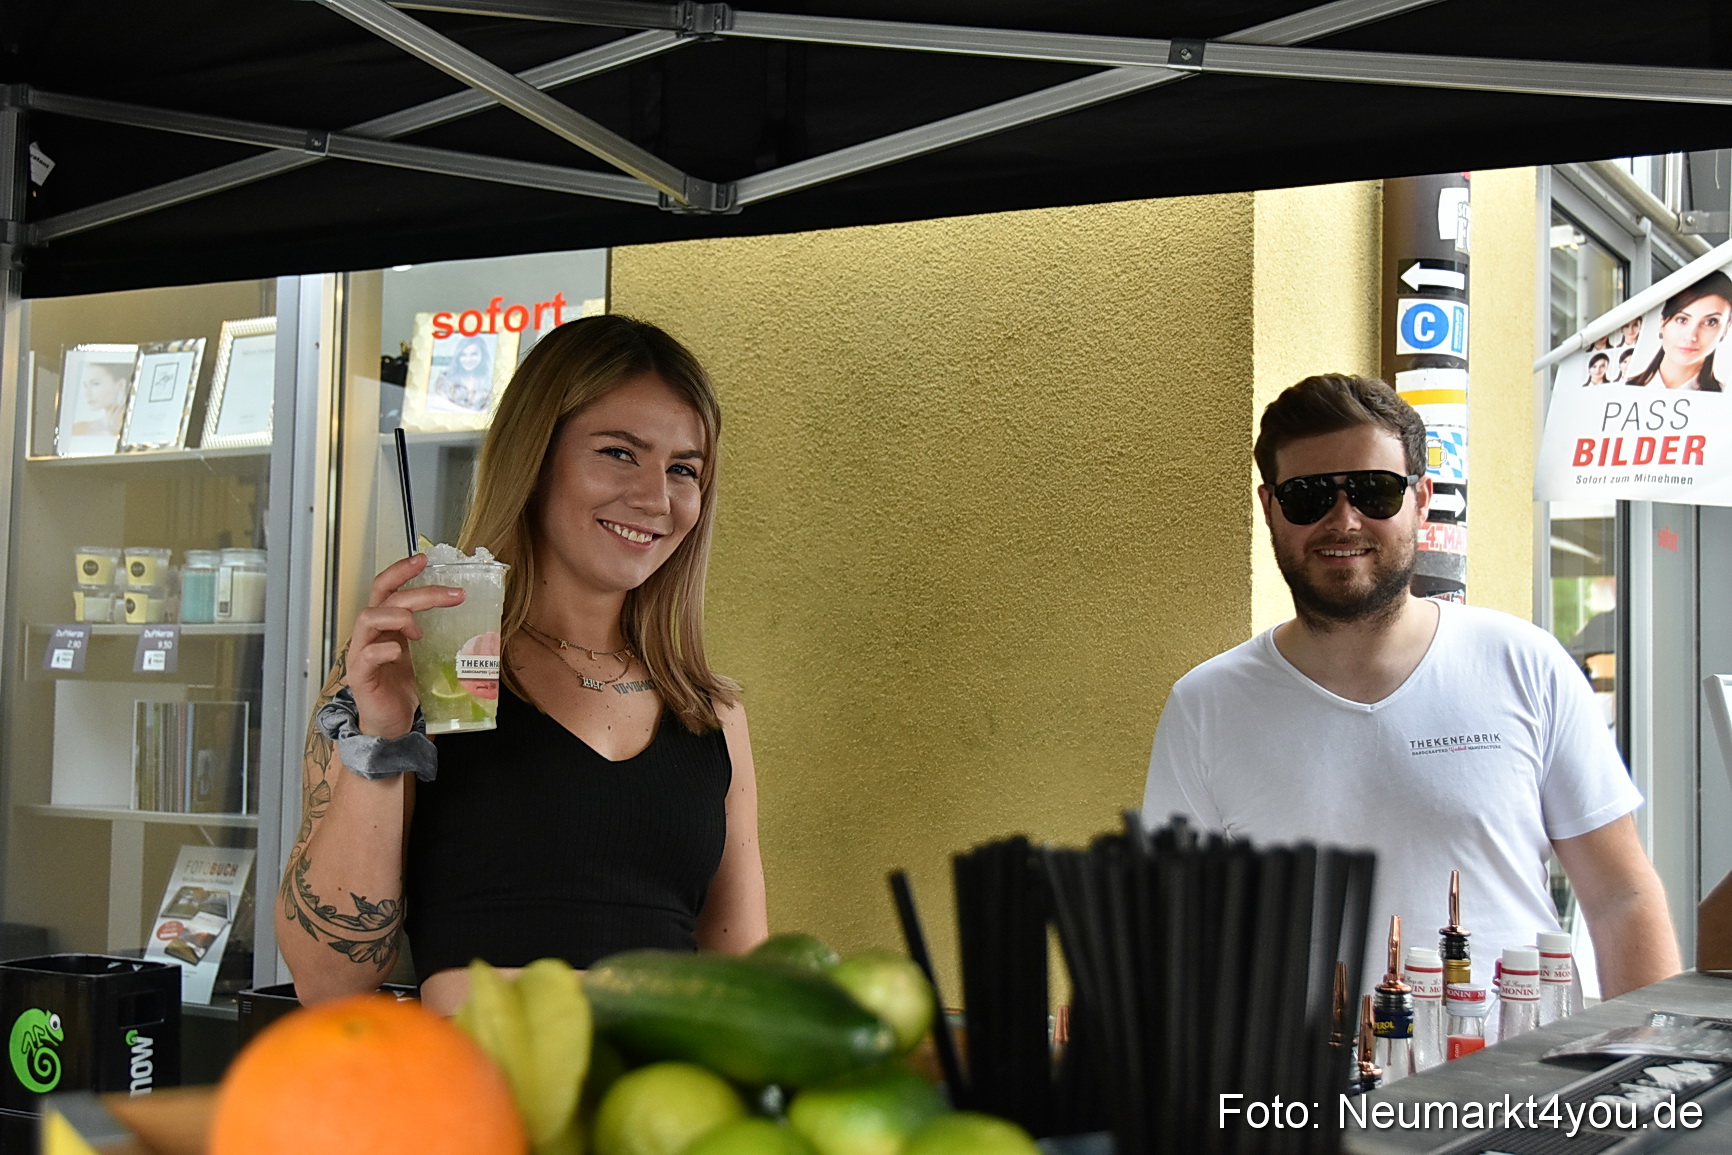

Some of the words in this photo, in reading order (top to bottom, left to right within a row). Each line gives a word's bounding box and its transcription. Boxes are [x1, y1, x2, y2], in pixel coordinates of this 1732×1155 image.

[432, 292, 566, 339] sofort
[1413, 310, 1436, 342] C
[1601, 398, 1691, 432] PASS
[1572, 435, 1707, 467] BILDER
[1576, 474, 1607, 485] Sofort
[1610, 476, 1630, 484] zum
[1634, 474, 1693, 486] Mitnehmen
[1409, 733, 1501, 748] THEKENFABRIK
[1501, 986, 1534, 996] MONIN
[130, 1036, 153, 1098] now
